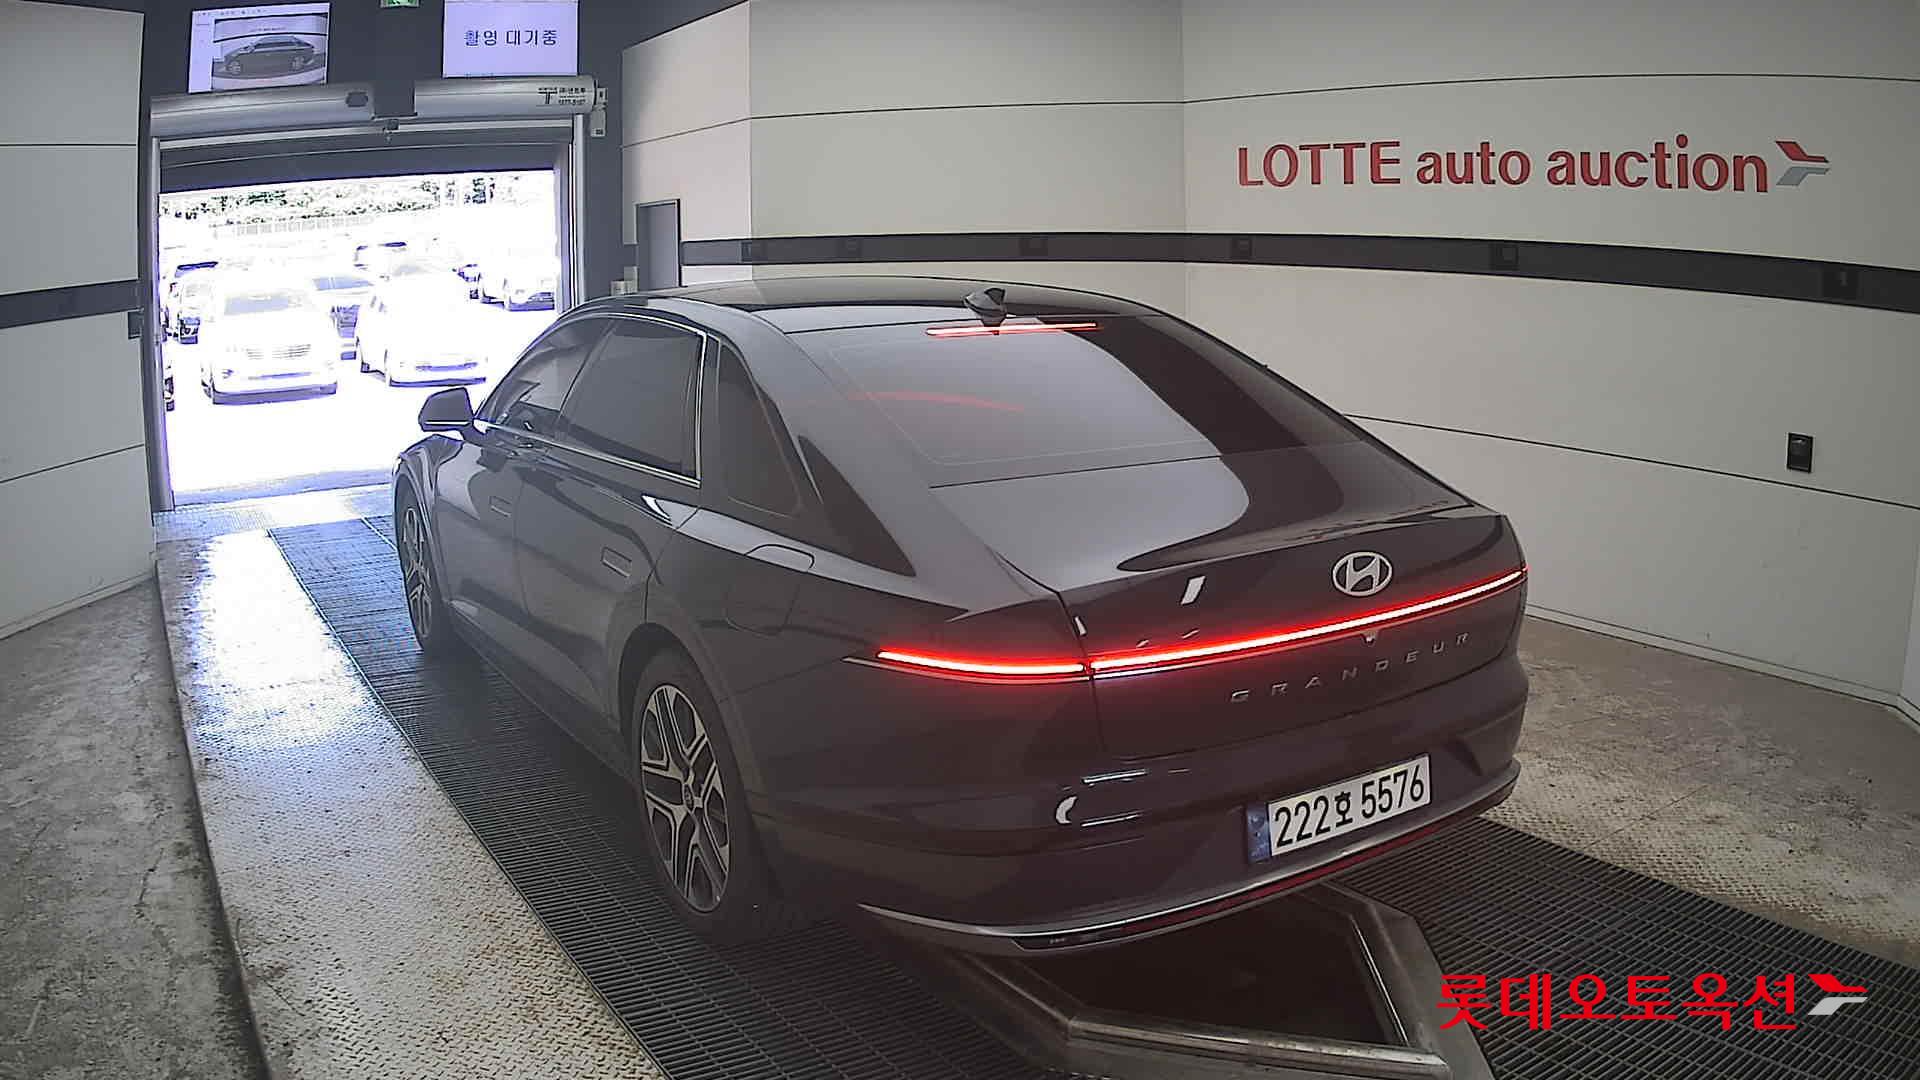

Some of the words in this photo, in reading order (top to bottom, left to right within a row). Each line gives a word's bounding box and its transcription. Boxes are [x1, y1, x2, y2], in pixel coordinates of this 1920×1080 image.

[506, 29, 557, 46] 대기중
[1238, 141, 1400, 187] LOTTE
[1416, 142, 1530, 186] auto
[1547, 134, 1769, 192] auction
[1231, 632, 1468, 702] GRANDEUR
[1275, 791, 1353, 848] 222호
[1361, 764, 1424, 819] 5576
